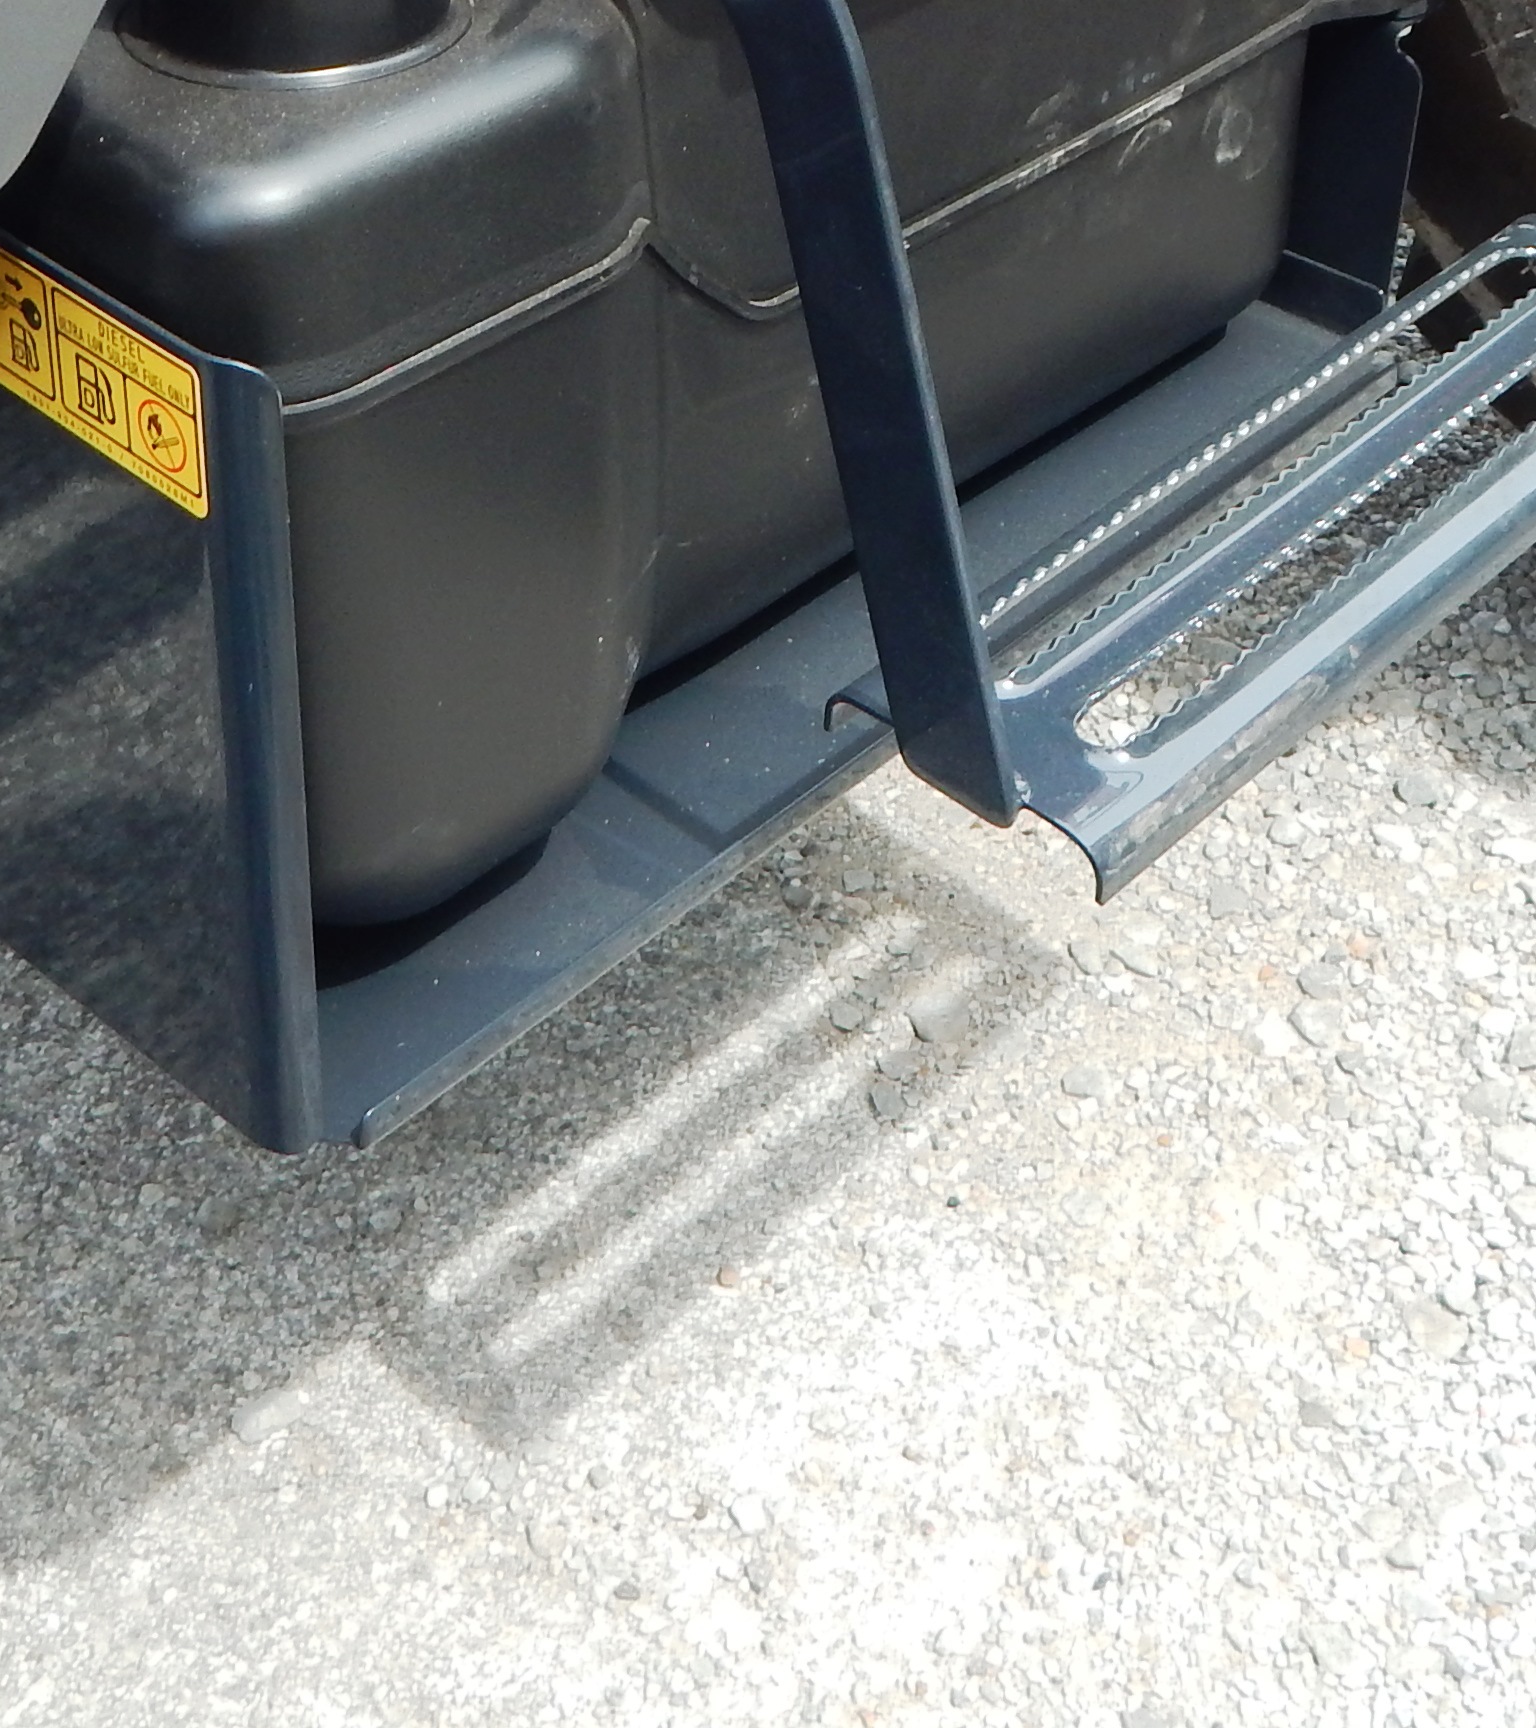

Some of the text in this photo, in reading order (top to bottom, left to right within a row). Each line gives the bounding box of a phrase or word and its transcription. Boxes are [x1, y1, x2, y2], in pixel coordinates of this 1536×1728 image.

[59, 315, 190, 410] ULTRA LOW SULFUR FUEL ONLY
[97, 320, 145, 365] DIESEL
